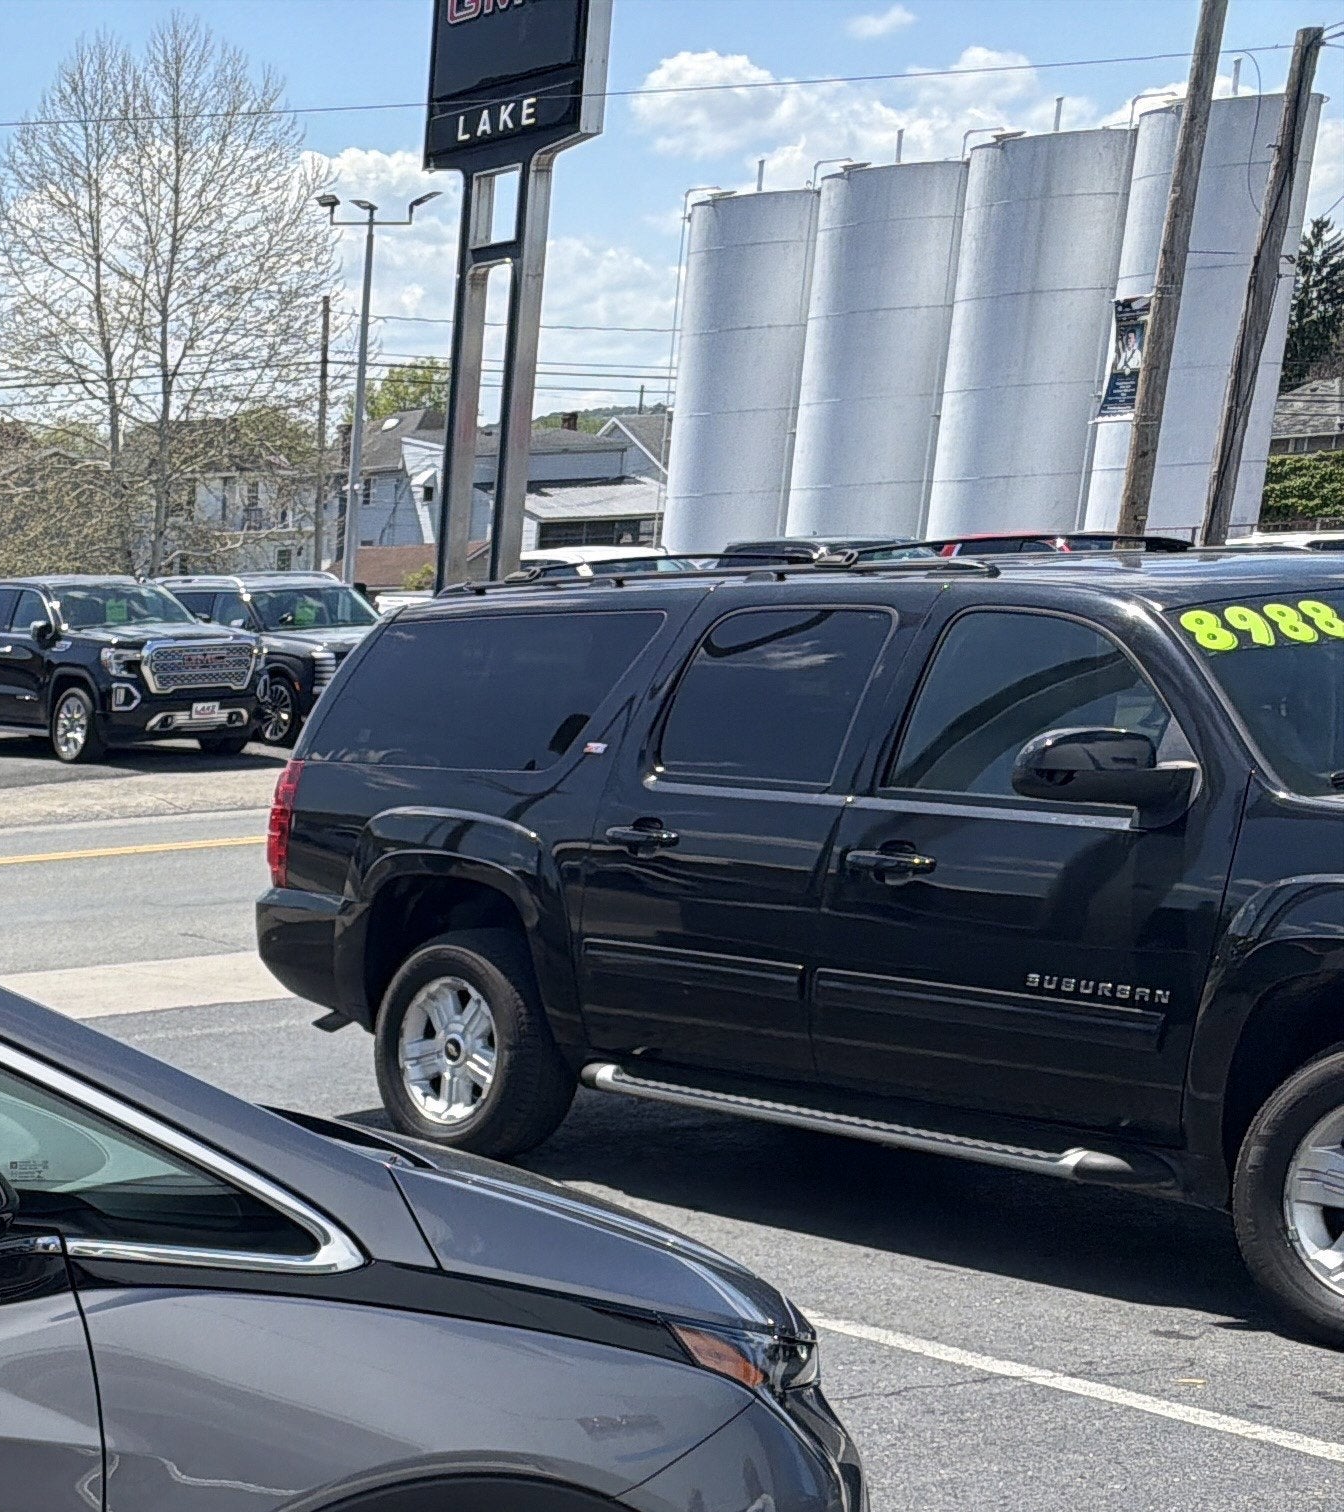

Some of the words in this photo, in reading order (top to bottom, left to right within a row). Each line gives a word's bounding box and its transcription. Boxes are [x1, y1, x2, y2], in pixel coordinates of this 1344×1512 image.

[457, 97, 537, 141] LAKE
[1180, 600, 1344, 650] 8988
[1025, 973, 1170, 1004] SUBURBAN
